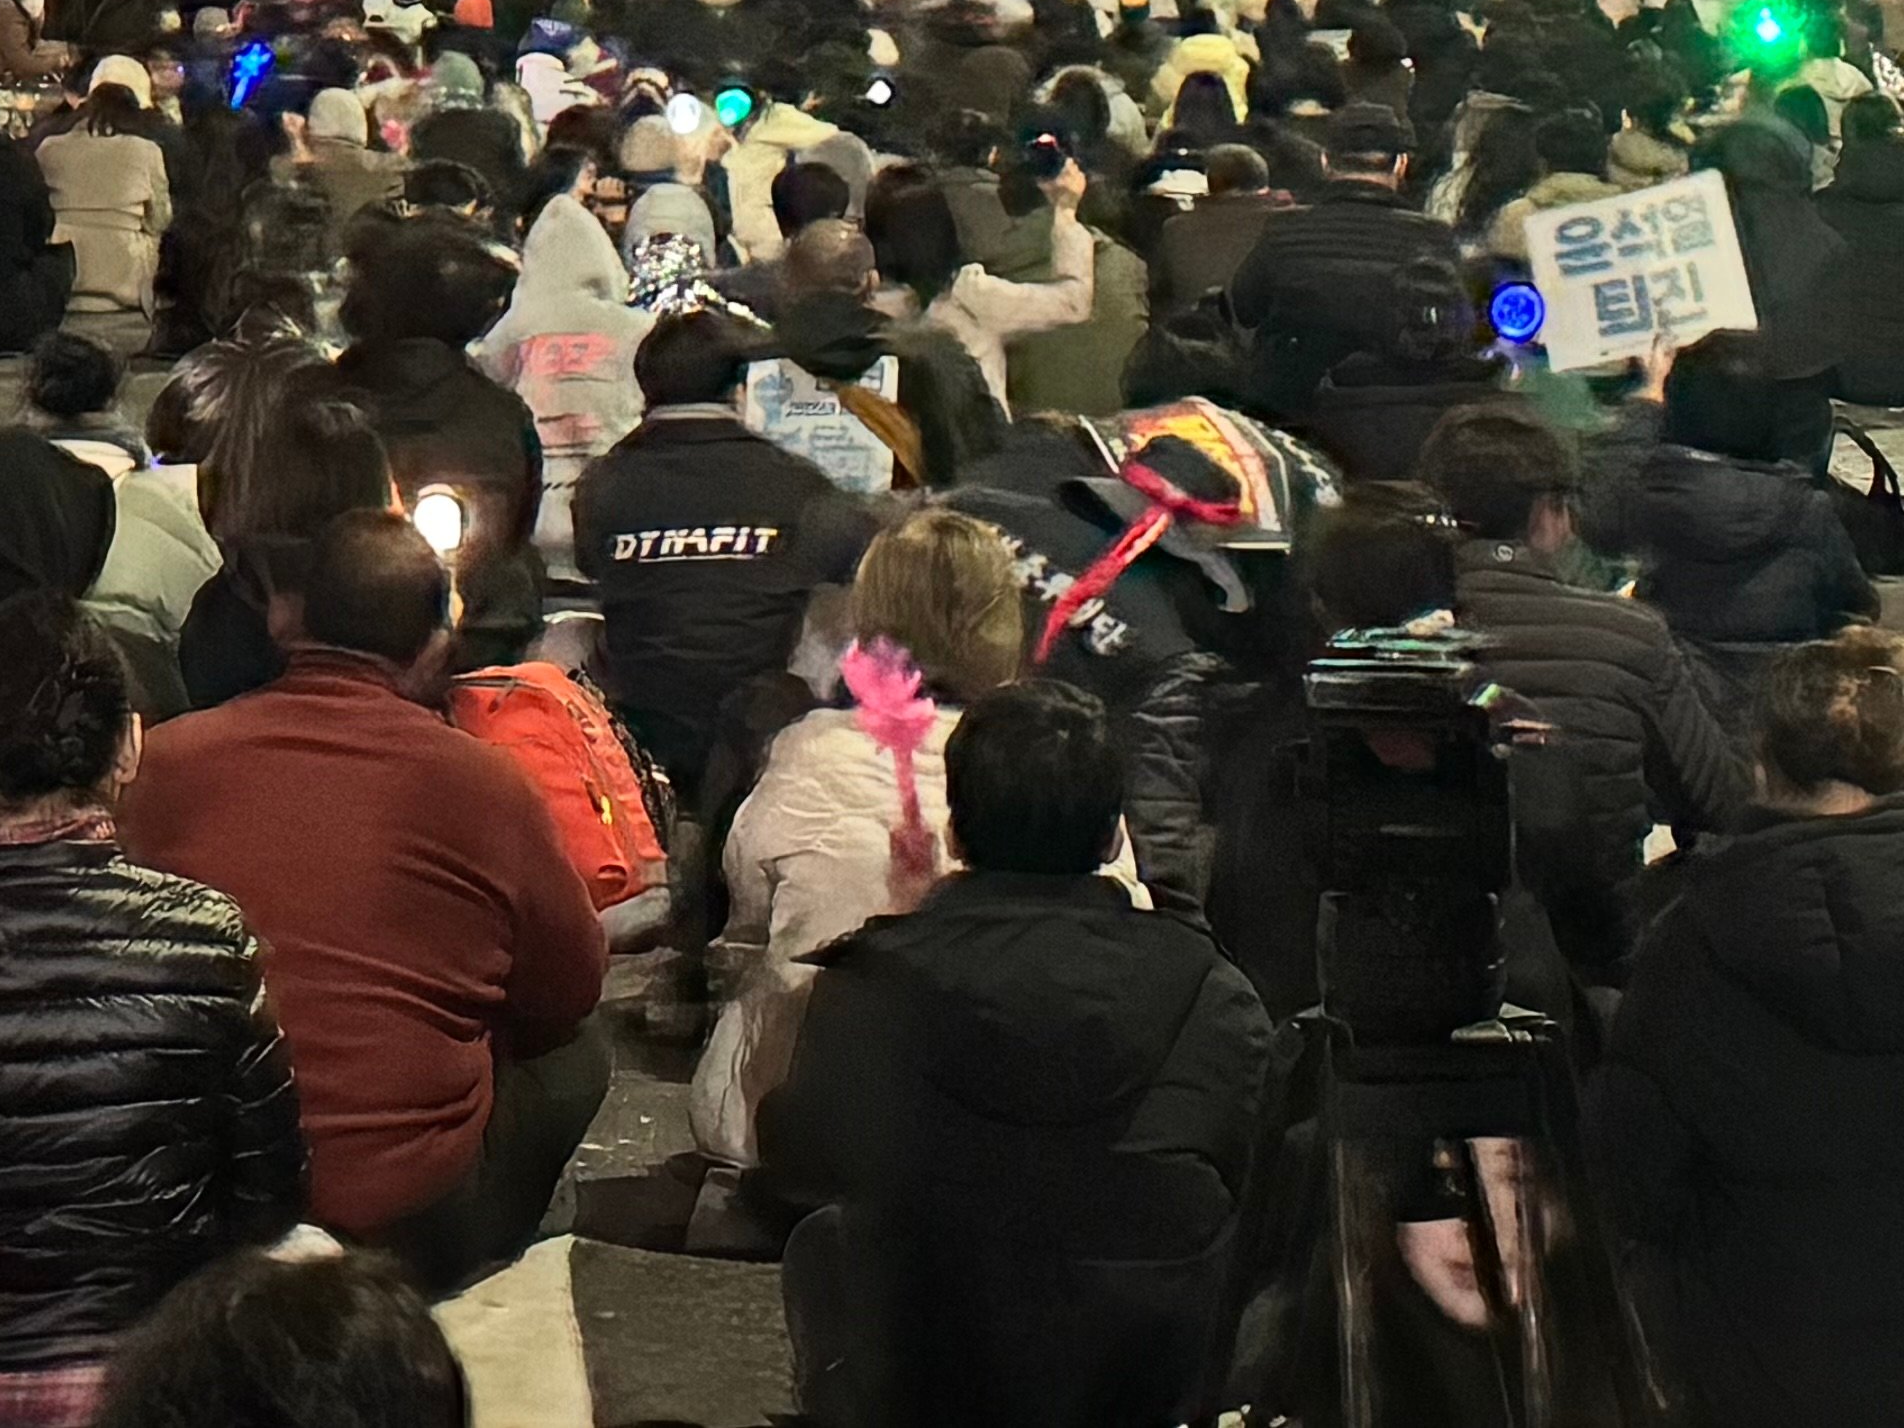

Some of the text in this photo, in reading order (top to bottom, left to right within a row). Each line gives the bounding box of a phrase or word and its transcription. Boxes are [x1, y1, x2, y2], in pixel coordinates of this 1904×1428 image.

[1553, 194, 1717, 279] 윤석열
[1593, 261, 1709, 341] 퇴진
[612, 526, 779, 561] DYNAFIT
